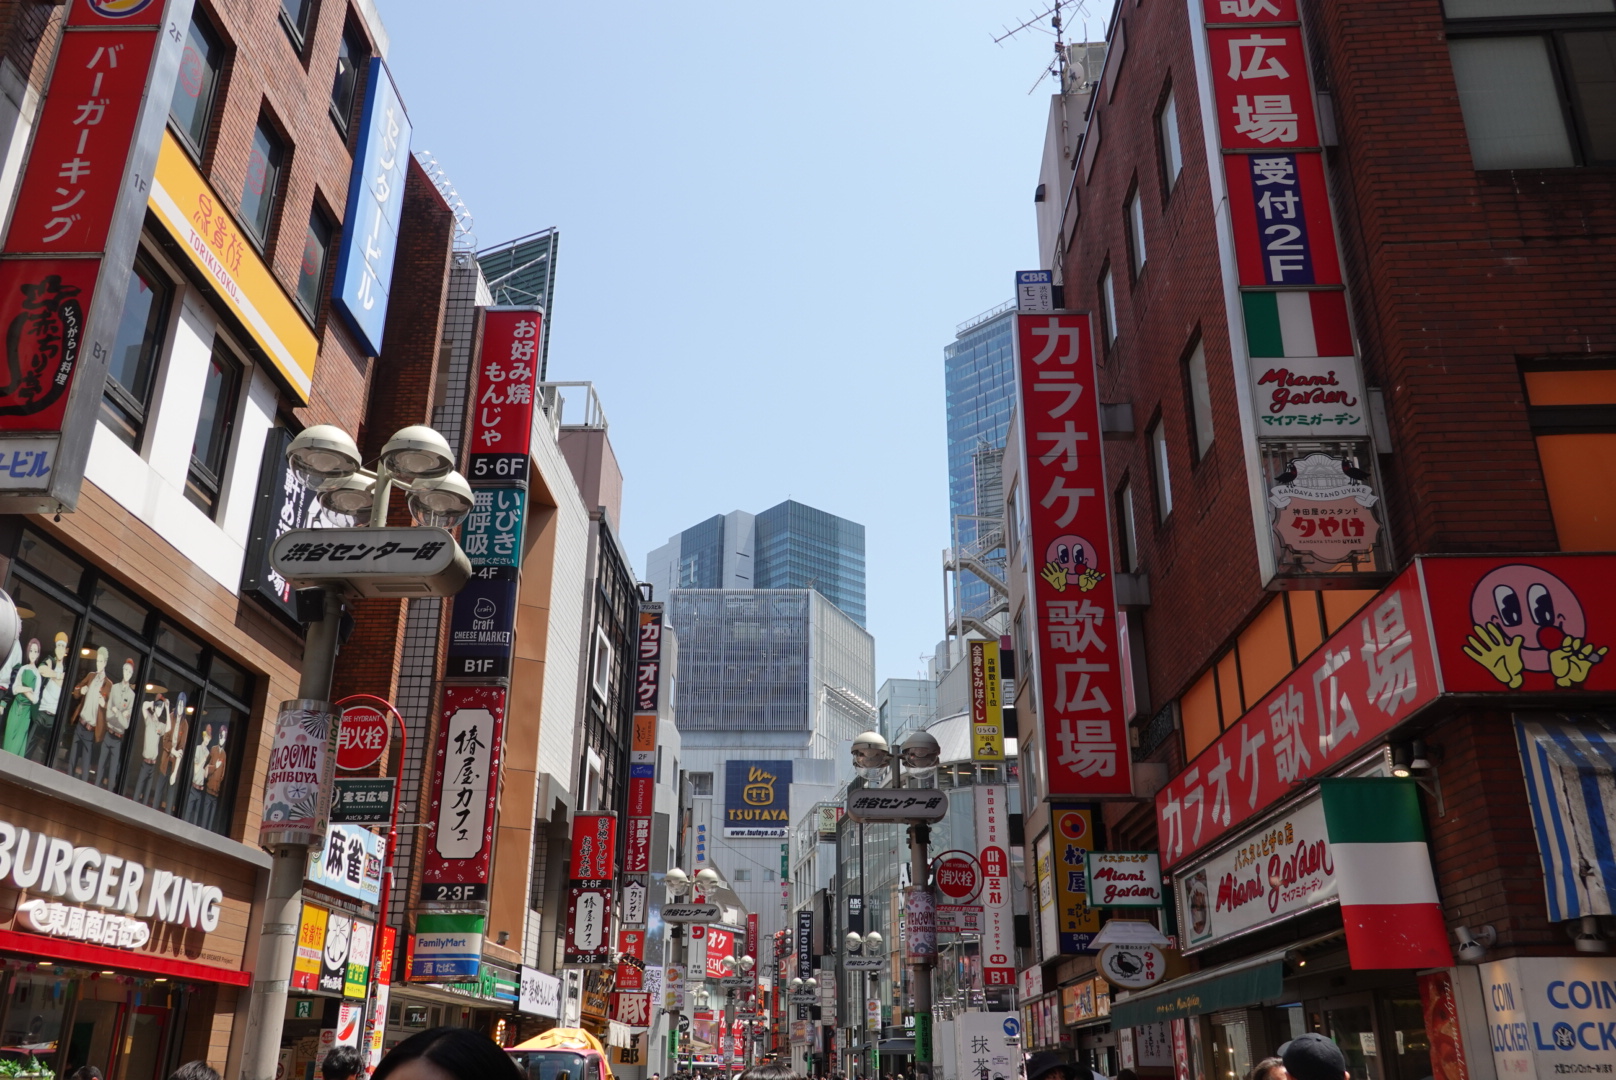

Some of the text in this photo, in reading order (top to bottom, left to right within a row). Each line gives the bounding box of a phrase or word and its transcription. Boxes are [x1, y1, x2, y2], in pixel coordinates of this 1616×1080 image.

[169, 22, 182, 43] 2F
[43, 44, 124, 243] バーガーキング
[133, 174, 146, 193] 1F
[358, 106, 399, 311] センタービル
[1253, 157, 1304, 282] 受付2F
[190, 229, 237, 298] TORIKIZOKU
[1021, 272, 1048, 282] CBR
[55, 306, 77, 386] とうがらし料理
[93, 341, 107, 364] B1
[505, 319, 536, 405] お好み焼
[1257, 367, 1339, 387] Miami
[480, 362, 506, 447] もんじゃ
[1261, 414, 1361, 426] マイアミガーデン
[0, 451, 50, 478] ービル
[1278, 488, 1312, 497] KANDAYA
[1342, 487, 1367, 495] UYAKE
[465, 490, 494, 555] 無呼吸
[494, 490, 521, 555] いびき
[1293, 508, 1359, 516] 神田屋のスタンド
[1291, 517, 1366, 537] 夕やけ
[280, 541, 447, 562] 渋谷センター街
[454, 631, 510, 643] CHEESE MARKET
[472, 619, 494, 630] Craft
[464, 659, 494, 673] B1F
[638, 622, 659, 700] カラオケ
[972, 645, 984, 721] 全身もみほぐし
[354, 715, 381, 723] HYDRANT
[1162, 589, 1419, 865] カラオケ歌広場
[270, 771, 319, 785] SHIBUYA
[450, 724, 486, 842] 椿屋カフェ
[342, 791, 389, 803] 宝石広場
[636, 779, 645, 814] Exchange
[853, 797, 942, 809] 渋谷センター街
[728, 809, 789, 821] TSUTAYA
[635, 819, 649, 870] 野郎ラーメン
[730, 829, 786, 837] www.tsutaya.co.jp
[326, 830, 364, 884] 麻雀
[578, 836, 592, 878] お好み焼
[596, 818, 609, 878] 築地もんじゃ
[1234, 822, 1294, 872] パスタとピザの店
[940, 870, 973, 887] 消火栓
[986, 850, 1002, 904] 마약포차
[1064, 844, 1087, 893] 松屋
[1093, 867, 1147, 881] Miami
[147, 868, 223, 933] KING
[1216, 863, 1265, 912] Miami
[1281, 877, 1323, 903] マイアミガーデン
[629, 890, 638, 920] カンダヤ
[663, 908, 717, 918] 渋谷センター街
[1067, 908, 1076, 929] 定食
[584, 896, 597, 946] 椿屋カフェ
[418, 938, 467, 950] FamilyMart
[423, 962, 456, 974] 酒 たばこ
[991, 971, 1009, 984] B1
[616, 994, 648, 1024] 豚
[1492, 982, 1515, 1012] COIN
[1491, 1022, 1530, 1053] LOCKER
[1554, 1064, 1613, 1074] 大型コインロッカーあります
